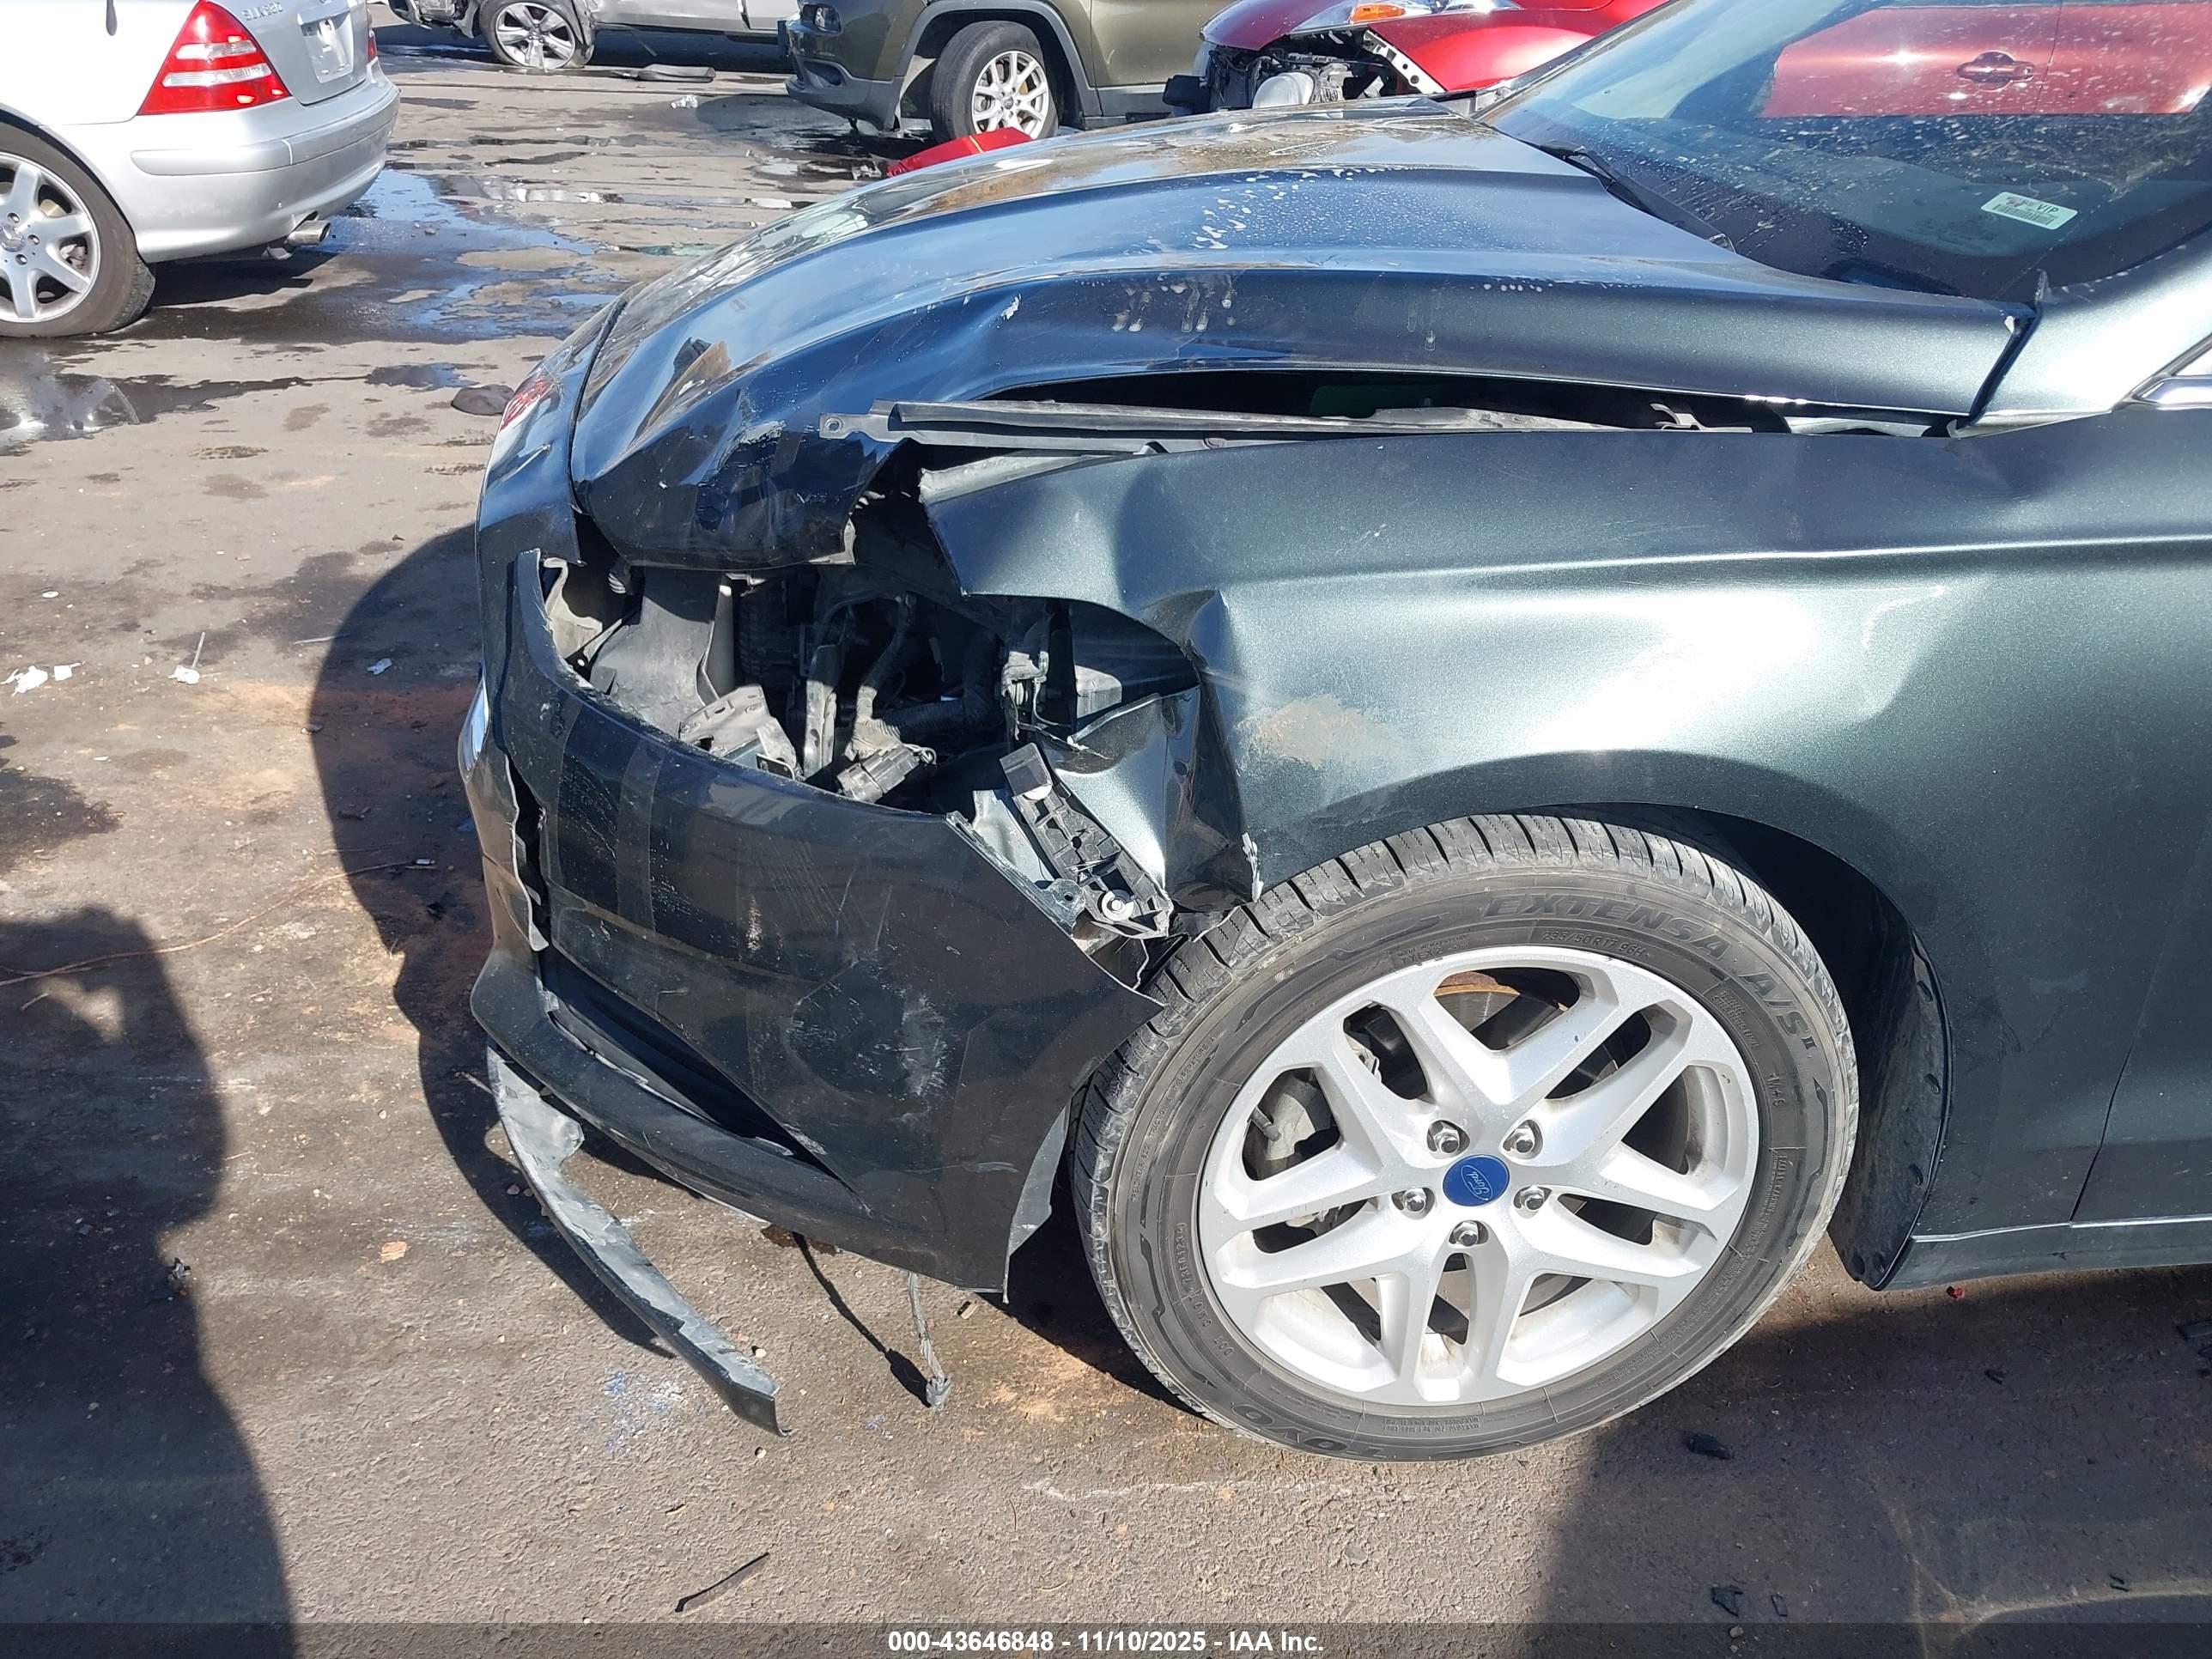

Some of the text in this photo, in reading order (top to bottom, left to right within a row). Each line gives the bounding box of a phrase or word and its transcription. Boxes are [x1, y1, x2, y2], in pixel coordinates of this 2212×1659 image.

[2038, 204, 2059, 213] VIP
[1480, 893, 1733, 960] EXTENSA
[1738, 972, 1810, 1036] A/S
[1148, 1107, 1169, 1138] TRACTION
[1173, 1044, 1209, 1092] TEMPERATURE
[1464, 1170, 1491, 1195] Ford
[1214, 1335, 1235, 1357] DOT
[1231, 1403, 1388, 1459] TOYO
